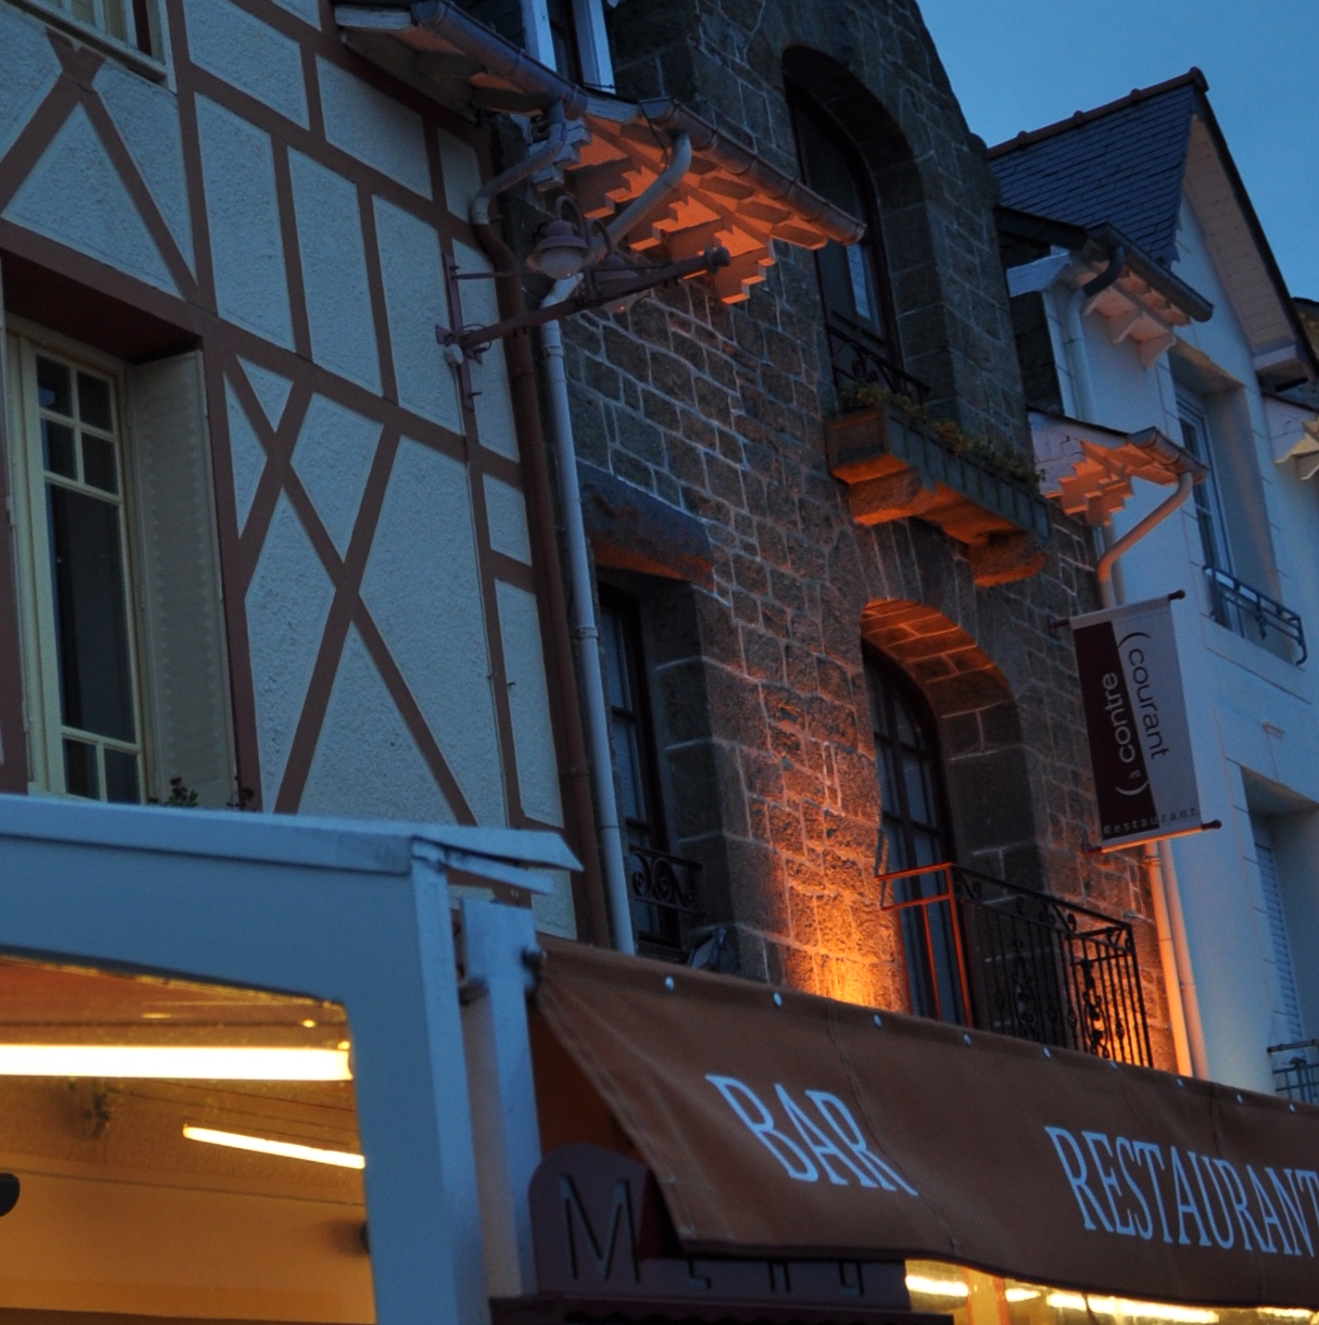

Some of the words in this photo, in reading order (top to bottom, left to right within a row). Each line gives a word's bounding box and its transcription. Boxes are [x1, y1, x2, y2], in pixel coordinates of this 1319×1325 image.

[1102, 672, 1136, 763] contre
[1103, 808, 1195, 834] Restaurant
[705, 1074, 918, 1197] BAR
